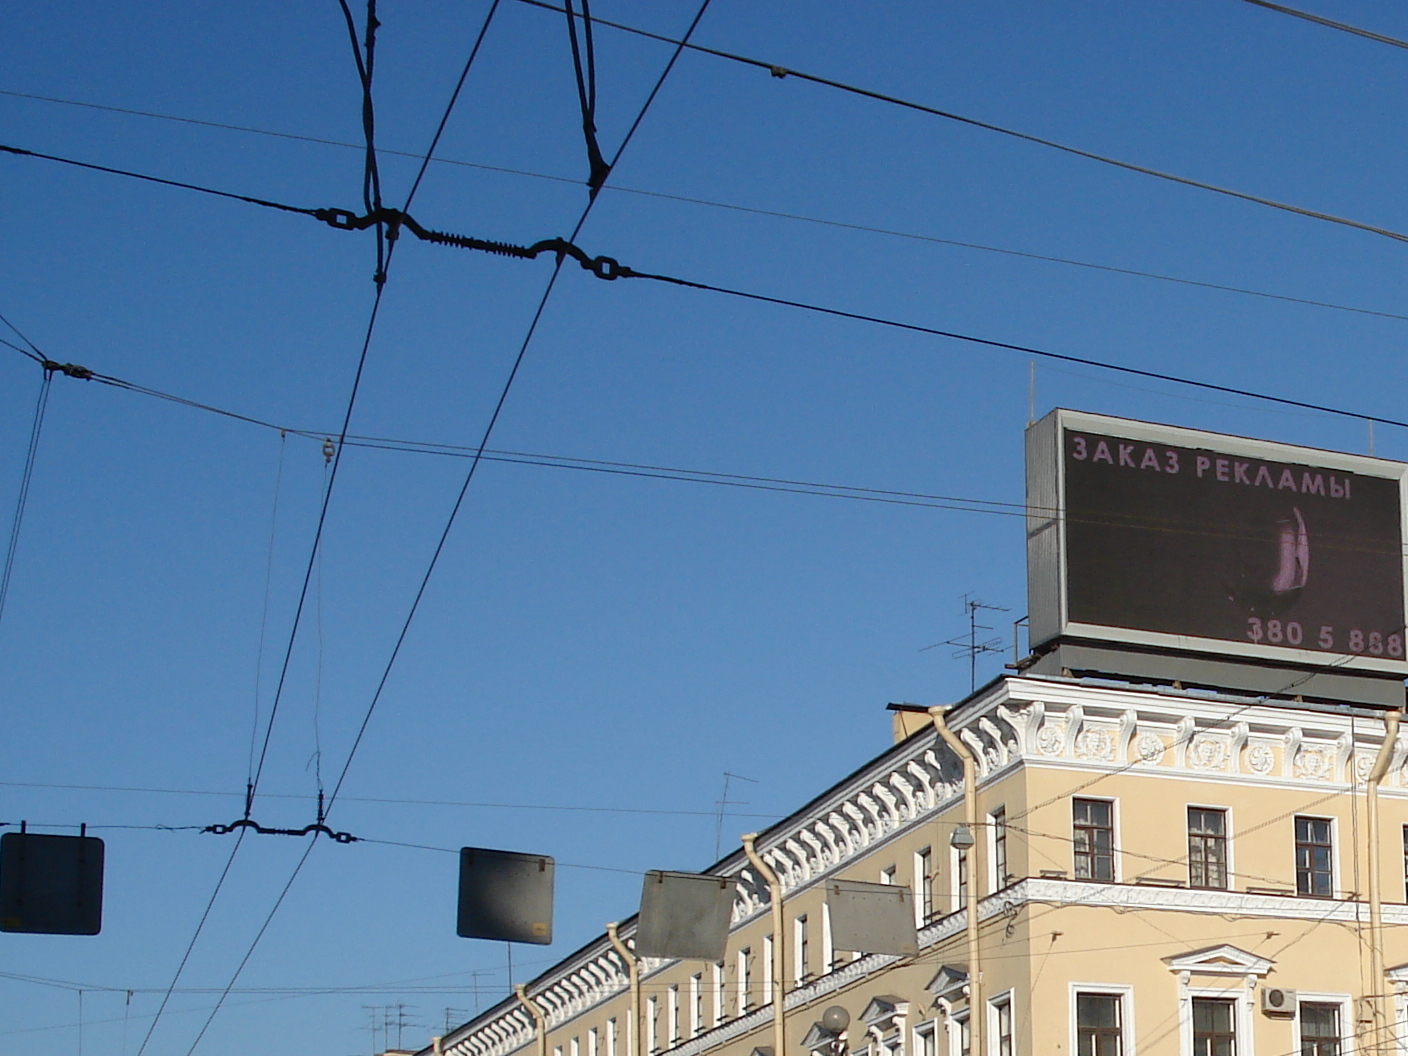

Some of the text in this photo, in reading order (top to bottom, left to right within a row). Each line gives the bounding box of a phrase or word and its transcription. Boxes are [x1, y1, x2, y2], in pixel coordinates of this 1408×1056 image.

[1072, 436, 1350, 500] ЗАКАЗ РЕКЛАМЫ
[1246, 616, 1402, 657] 380 5 888
